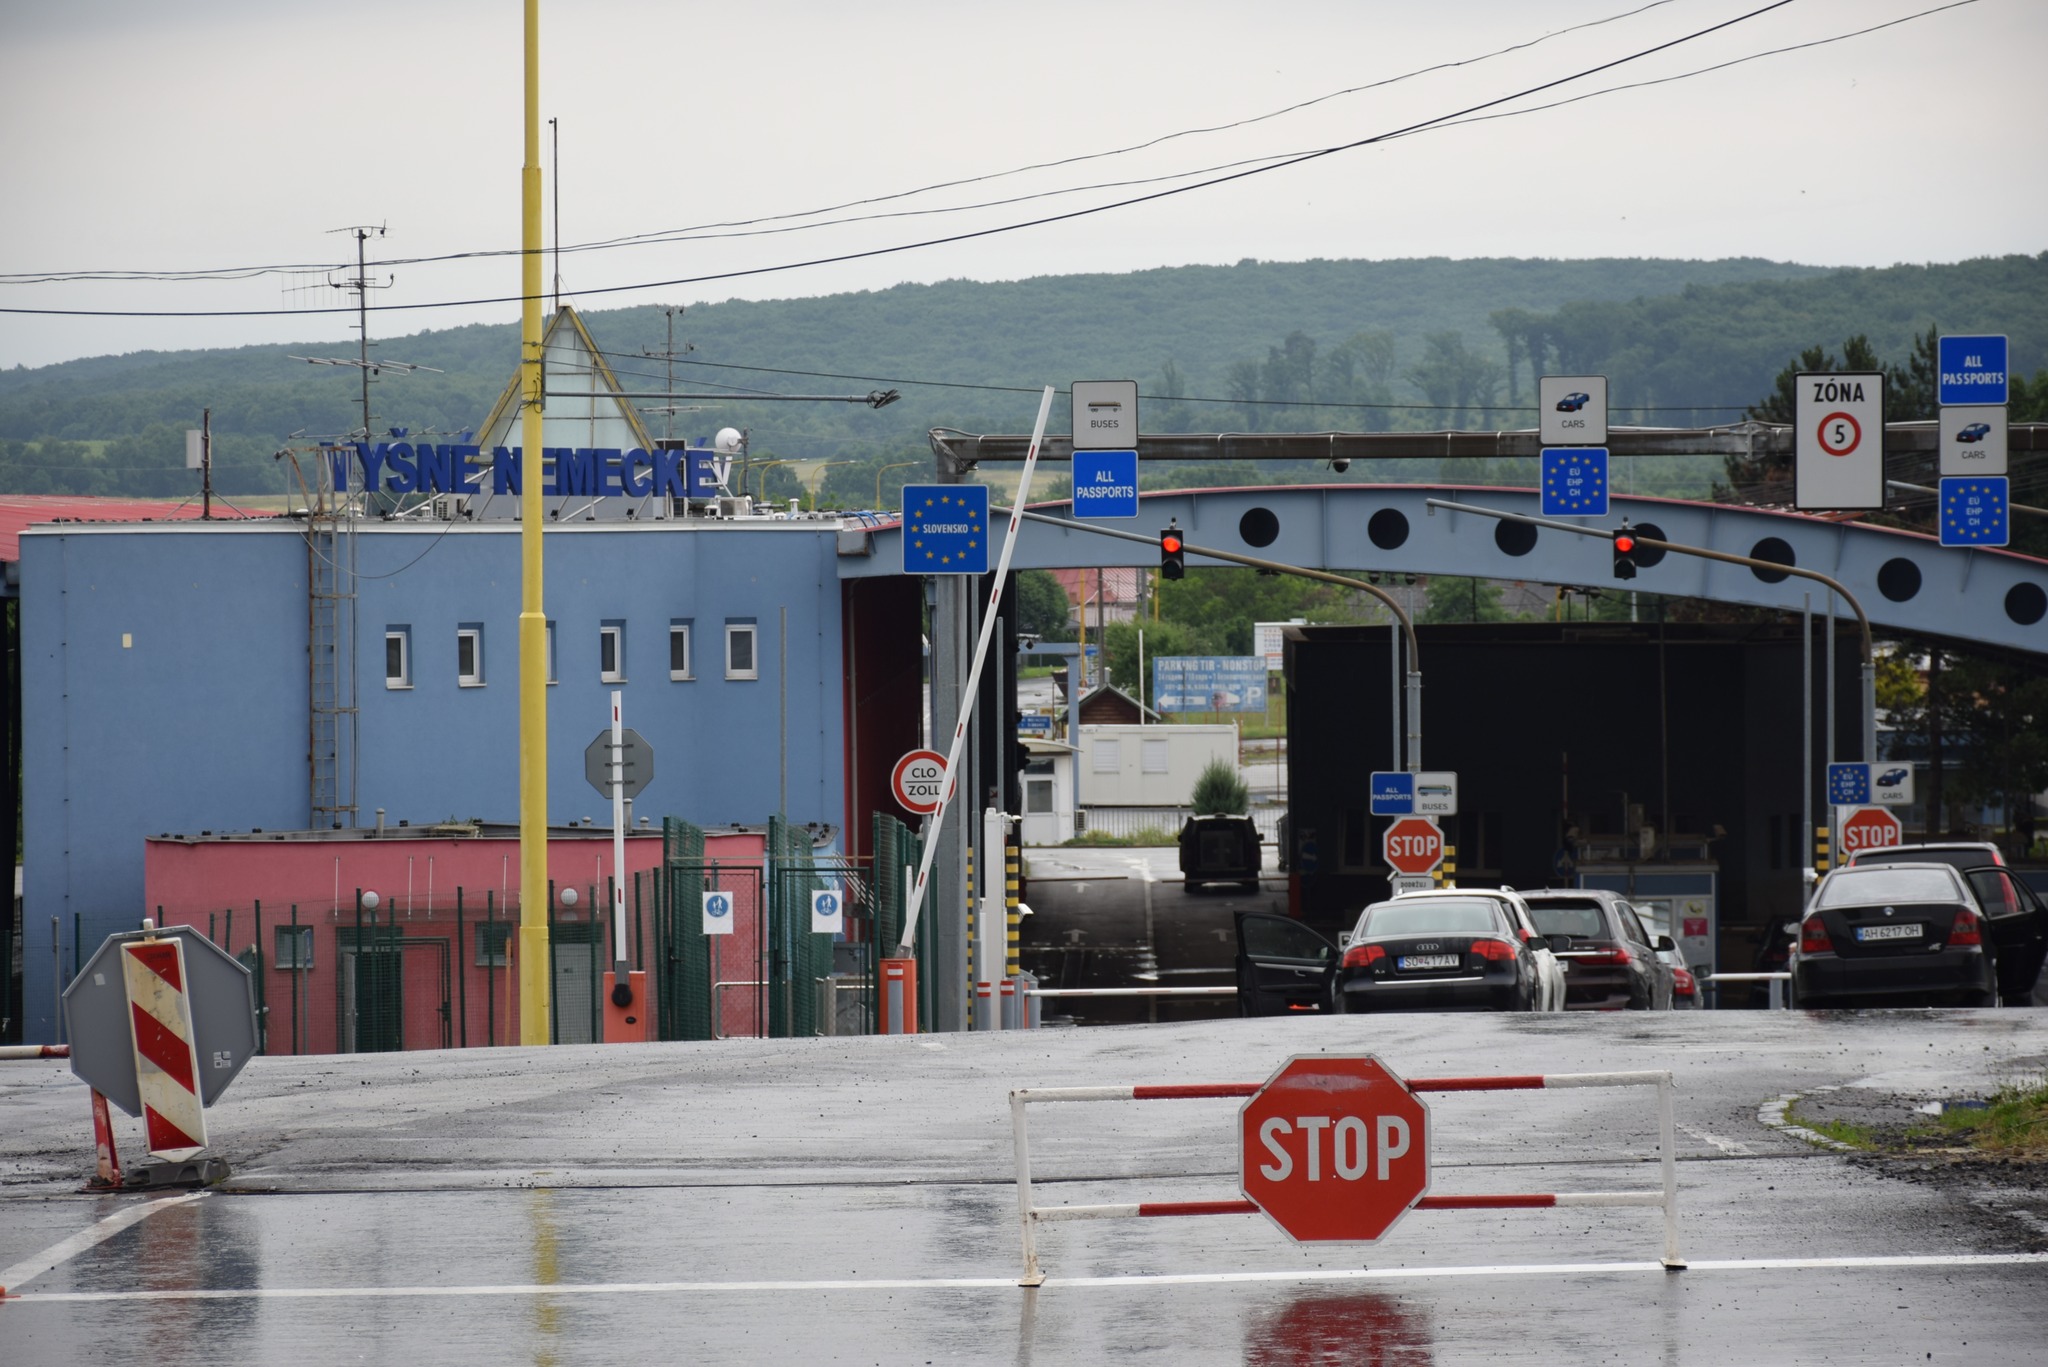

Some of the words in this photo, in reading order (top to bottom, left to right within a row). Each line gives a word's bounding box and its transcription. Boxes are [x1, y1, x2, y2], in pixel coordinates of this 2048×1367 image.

[1965, 355, 1982, 367] ALL
[1943, 372, 2004, 385] PASSPORTS
[1814, 378, 1865, 402] ZÓNA
[1091, 420, 1119, 428] BUSES
[1562, 420, 1585, 428] CARS
[1835, 424, 1845, 444] 5
[1962, 451, 1986, 459] CARS
[319, 427, 480, 495] VYŠNÉ
[493, 437, 716, 498] NEMECKÉ
[1096, 471, 1114, 482] ALL
[1567, 478, 1583, 486] EHP
[1077, 486, 1134, 498] PASSPORTS
[1569, 488, 1580, 496] CH
[1966, 507, 1982, 516] EHP
[1968, 517, 1980, 526] CH
[923, 523, 969, 533] SLOVENSKO
[1158, 660, 1198, 671] PARKING
[1201, 660, 1215, 671] TIR
[1223, 660, 1266, 671] NONSTOP
[1247, 686, 1262, 705] P
[912, 767, 937, 778] CLO
[908, 785, 940, 796] ZOLL
[1847, 825, 1895, 847] STOP
[1390, 835, 1438, 857] STOP
[1400, 880, 1426, 888] DODRŽUJ
[1864, 928, 1878, 938] AH
[1880, 927, 1902, 938] 6217
[1905, 926, 1919, 936] OH
[1405, 957, 1419, 967] SO
[1424, 955, 1457, 966] 417AV
[1260, 1116, 1410, 1181] STOP
